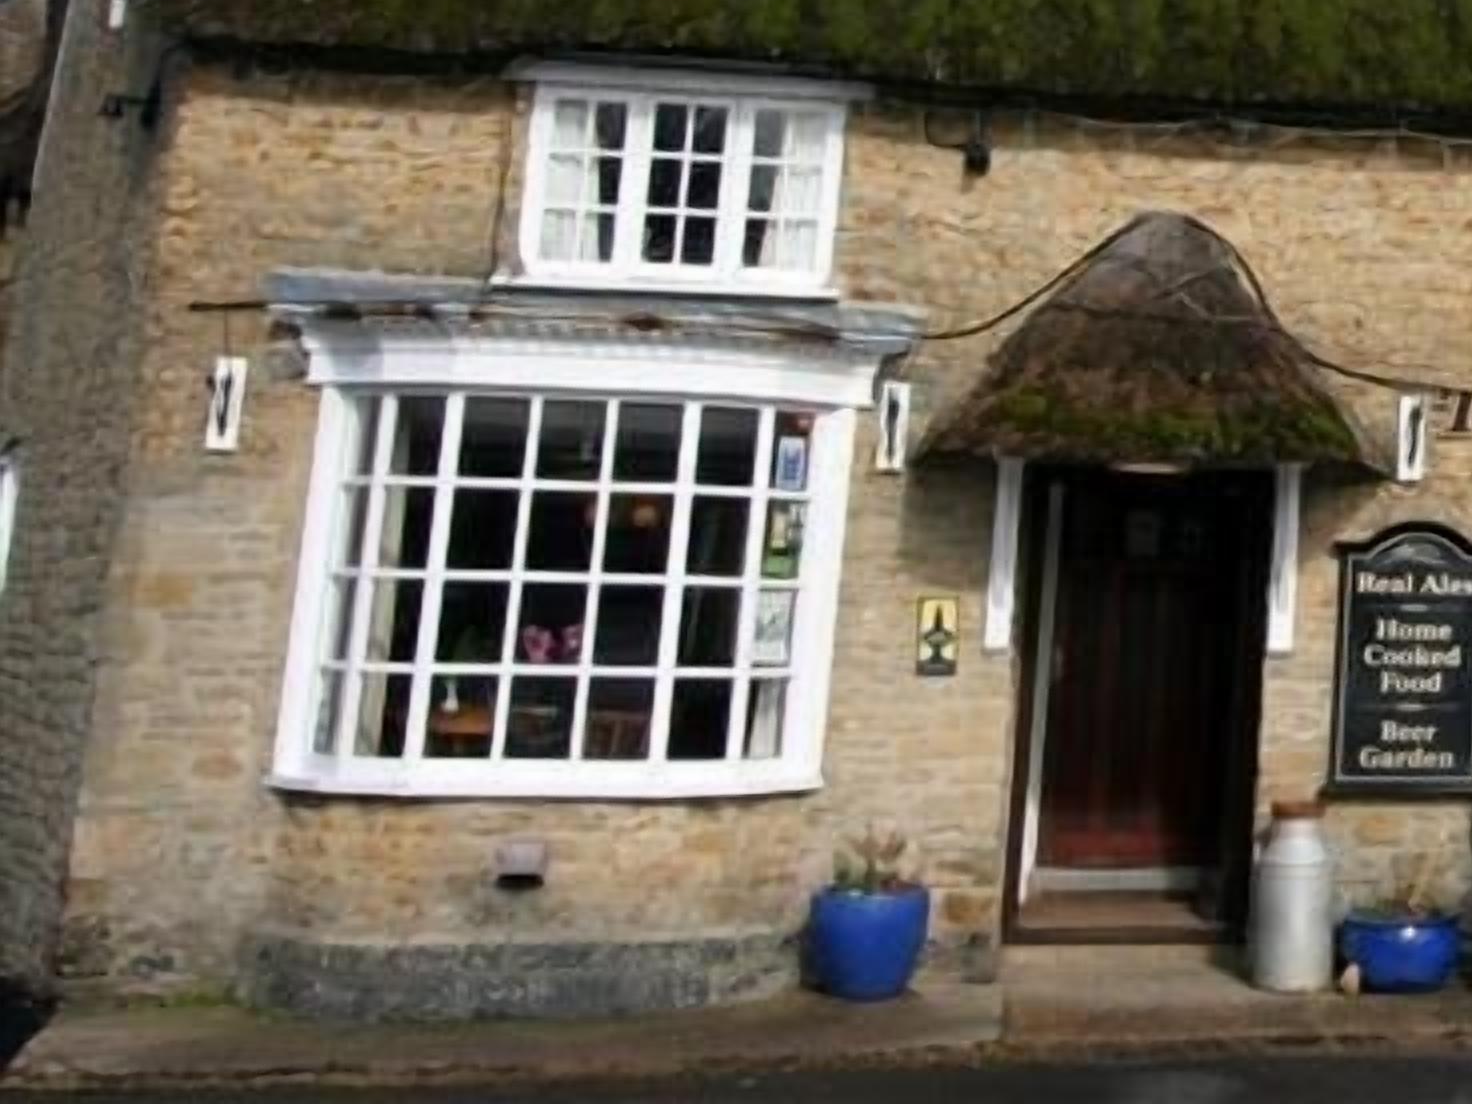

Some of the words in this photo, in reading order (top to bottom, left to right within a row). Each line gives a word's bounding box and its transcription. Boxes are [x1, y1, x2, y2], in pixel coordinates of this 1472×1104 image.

[1357, 571, 1414, 594] Real
[1376, 618, 1453, 640] Home
[1363, 644, 1462, 666] Cooked
[1379, 671, 1442, 693] Food
[1380, 720, 1437, 742] Beer
[1358, 748, 1454, 769] Garden
